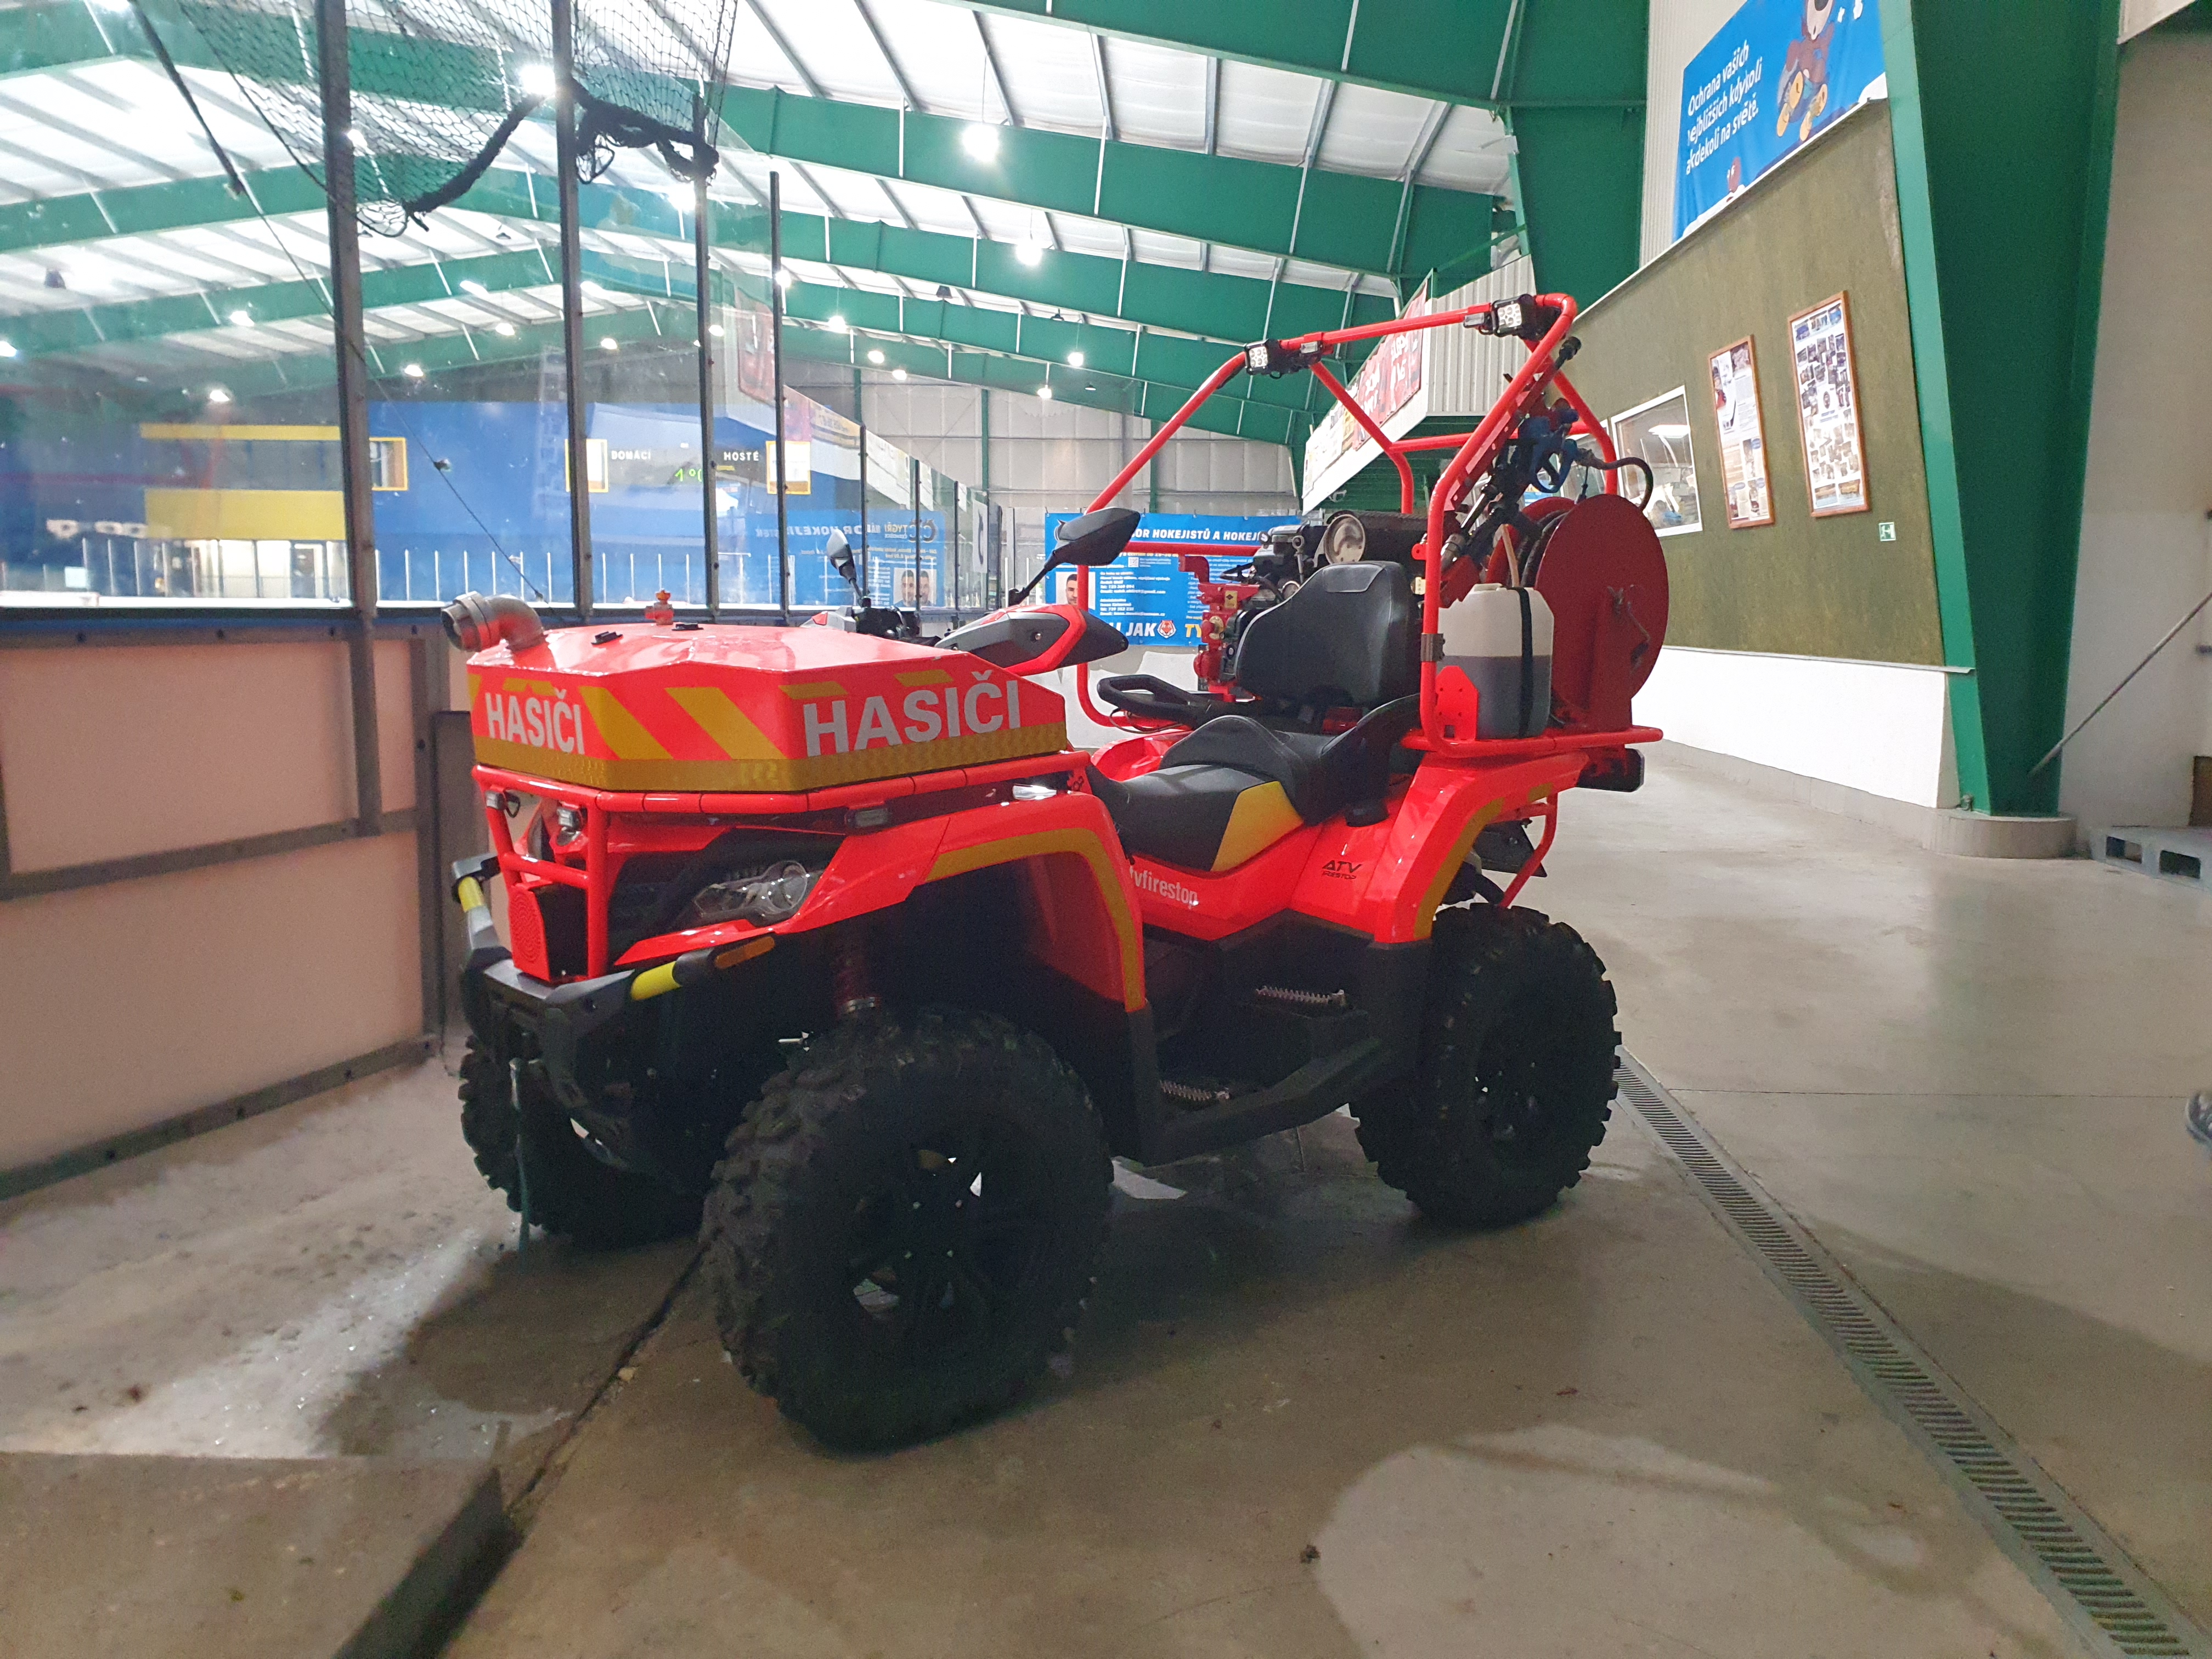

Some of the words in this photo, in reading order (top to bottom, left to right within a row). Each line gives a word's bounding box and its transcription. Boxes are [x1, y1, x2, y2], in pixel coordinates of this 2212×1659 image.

[1688, 86, 1721, 116] Ochrana
[1722, 40, 1749, 83] vašich
[1729, 57, 1763, 107] kdykoli
[1720, 122, 1731, 145] na
[723, 450, 759, 461] HOSTÉ
[1132, 528, 1150, 539] OR
[1153, 528, 1210, 540] HOKEJISTŮ
[1212, 531, 1221, 540] A
[1126, 622, 1157, 637] JAK
[485, 689, 585, 755] HASIČI
[803, 669, 1021, 757] HASIČI
[1322, 860, 1363, 873] ATV
[1129, 865, 1199, 910] tvfirestop
